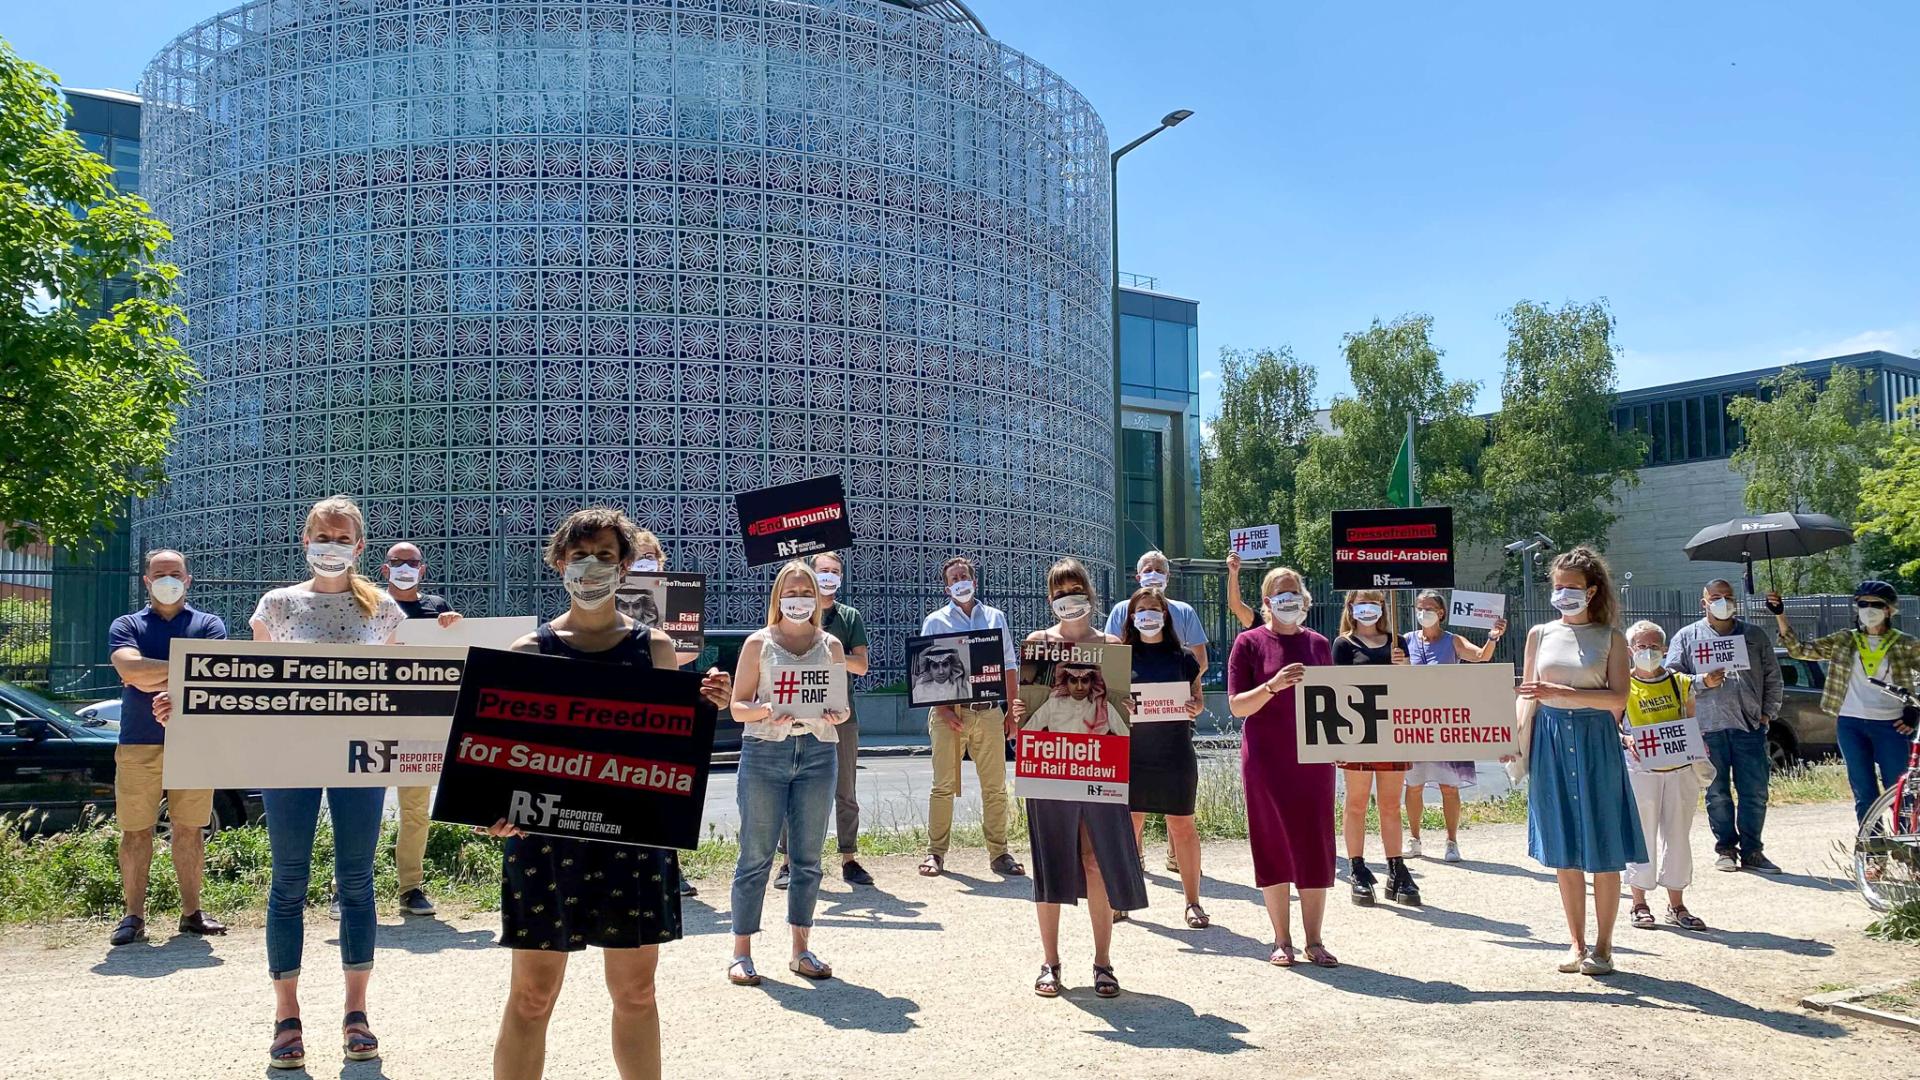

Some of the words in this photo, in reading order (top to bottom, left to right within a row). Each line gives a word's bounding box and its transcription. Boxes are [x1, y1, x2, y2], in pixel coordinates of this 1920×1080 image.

[748, 507, 841, 536] #EndImpunity
[1250, 529, 1269, 539] FREE
[1251, 540, 1268, 550] RAIF
[1336, 549, 1354, 560] für
[1357, 550, 1448, 560] Saudi-Arabien
[1453, 601, 1475, 616] RSF
[680, 613, 700, 622] Raif
[662, 622, 699, 631] Badawi
[1713, 640, 1735, 651] FREE
[1024, 644, 1104, 664] #FreeRaif
[1715, 651, 1735, 663] RAIF
[190, 657, 275, 679] Keine
[282, 659, 388, 681] Freiheit
[395, 662, 460, 682] ohne
[982, 664, 1001, 674] Raif
[801, 670, 830, 685] FREE
[969, 673, 1002, 683] Badawi
[188, 690, 397, 712] Pressefreiheit.
[801, 688, 828, 704] RAIF
[478, 692, 557, 721] Press
[568, 701, 693, 732] Freedom
[1144, 707, 1160, 715] OHNE
[1304, 684, 1389, 746] RSF
[1392, 708, 1471, 725] REPORTER
[1393, 728, 1435, 744] OHNE
[1440, 727, 1511, 744] GRENZEN
[1659, 724, 1687, 739] FREE
[1021, 735, 1101, 762] Freiheit
[1663, 740, 1688, 754] RAIF
[348, 740, 399, 773] RSF
[400, 753, 443, 763] REPORTER
[400, 763, 423, 773] OHNE
[425, 763, 442, 773] GRE
[459, 737, 501, 764] for
[507, 744, 592, 778] Saudi
[598, 758, 693, 793] Arabia
[1020, 761, 1038, 774] für
[1041, 762, 1066, 775] Raif
[1070, 763, 1116, 778] Badawi
[507, 790, 561, 827] RSF
[559, 808, 603, 822] REPORTER
[557, 818, 581, 831] OHNE
[582, 821, 622, 835] GRENZEN
